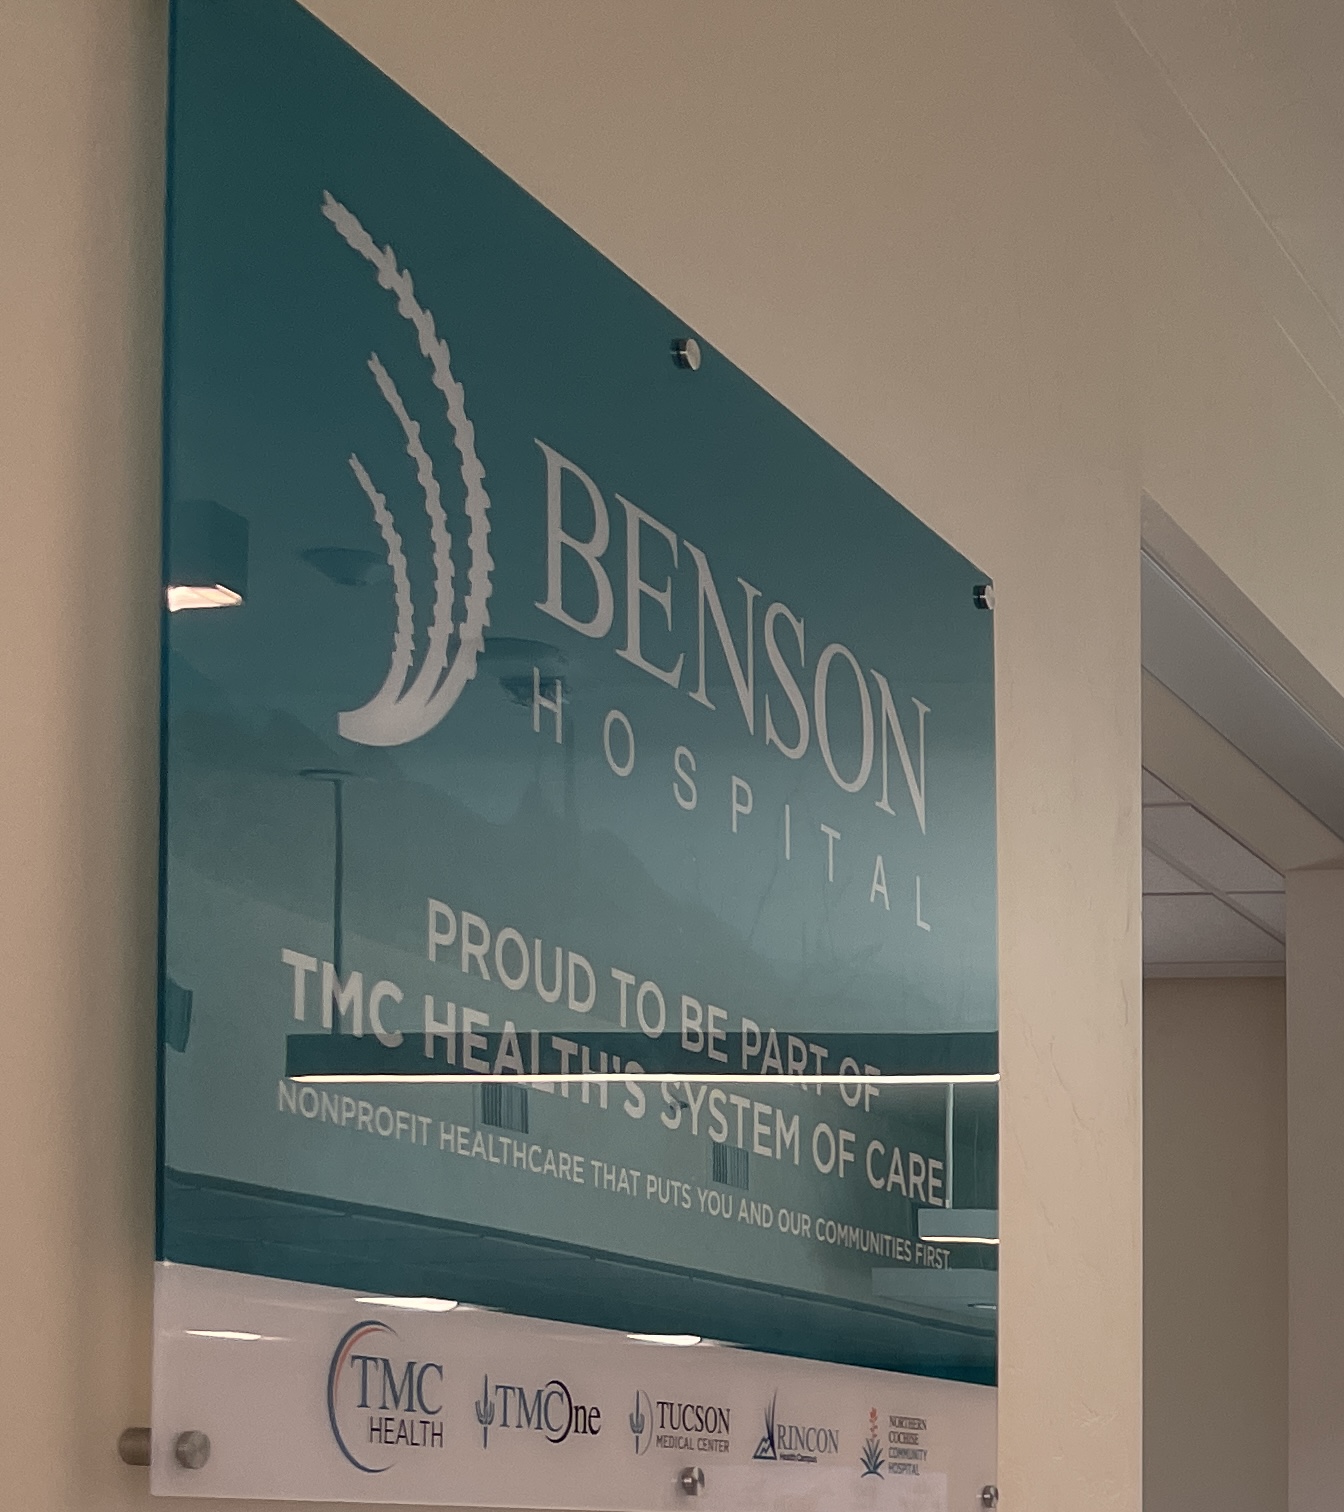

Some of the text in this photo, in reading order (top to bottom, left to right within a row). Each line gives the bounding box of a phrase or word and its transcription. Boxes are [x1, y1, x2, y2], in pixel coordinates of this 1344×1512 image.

[534, 438, 931, 835] BENSON
[534, 667, 931, 931] HOSPITAL
[281, 948, 404, 1048] TMC
[424, 994, 646, 1119] HEALTH'S
[660, 1078, 799, 1166] SYSTEM
[812, 1122, 856, 1178] OF
[428, 897, 881, 1112] PROUD TO BE PART OF
[279, 1080, 432, 1147] NONPROFIT
[440, 1121, 584, 1184] HEALTHCARE
[591, 1160, 641, 1197] THAT
[647, 1174, 692, 1210] PUTS
[697, 1187, 733, 1219] YOU
[738, 1198, 773, 1229] AND
[778, 1208, 811, 1239] OUR
[815, 1218, 912, 1263] COMMUNITIES
[351, 1354, 444, 1416] TMC
[369, 1416, 444, 1448] HEALTH
[656, 1401, 731, 1435] TUCSON
[656, 1435, 730, 1453] MEDICAL CENTER
[777, 1423, 840, 1454] RINCON
